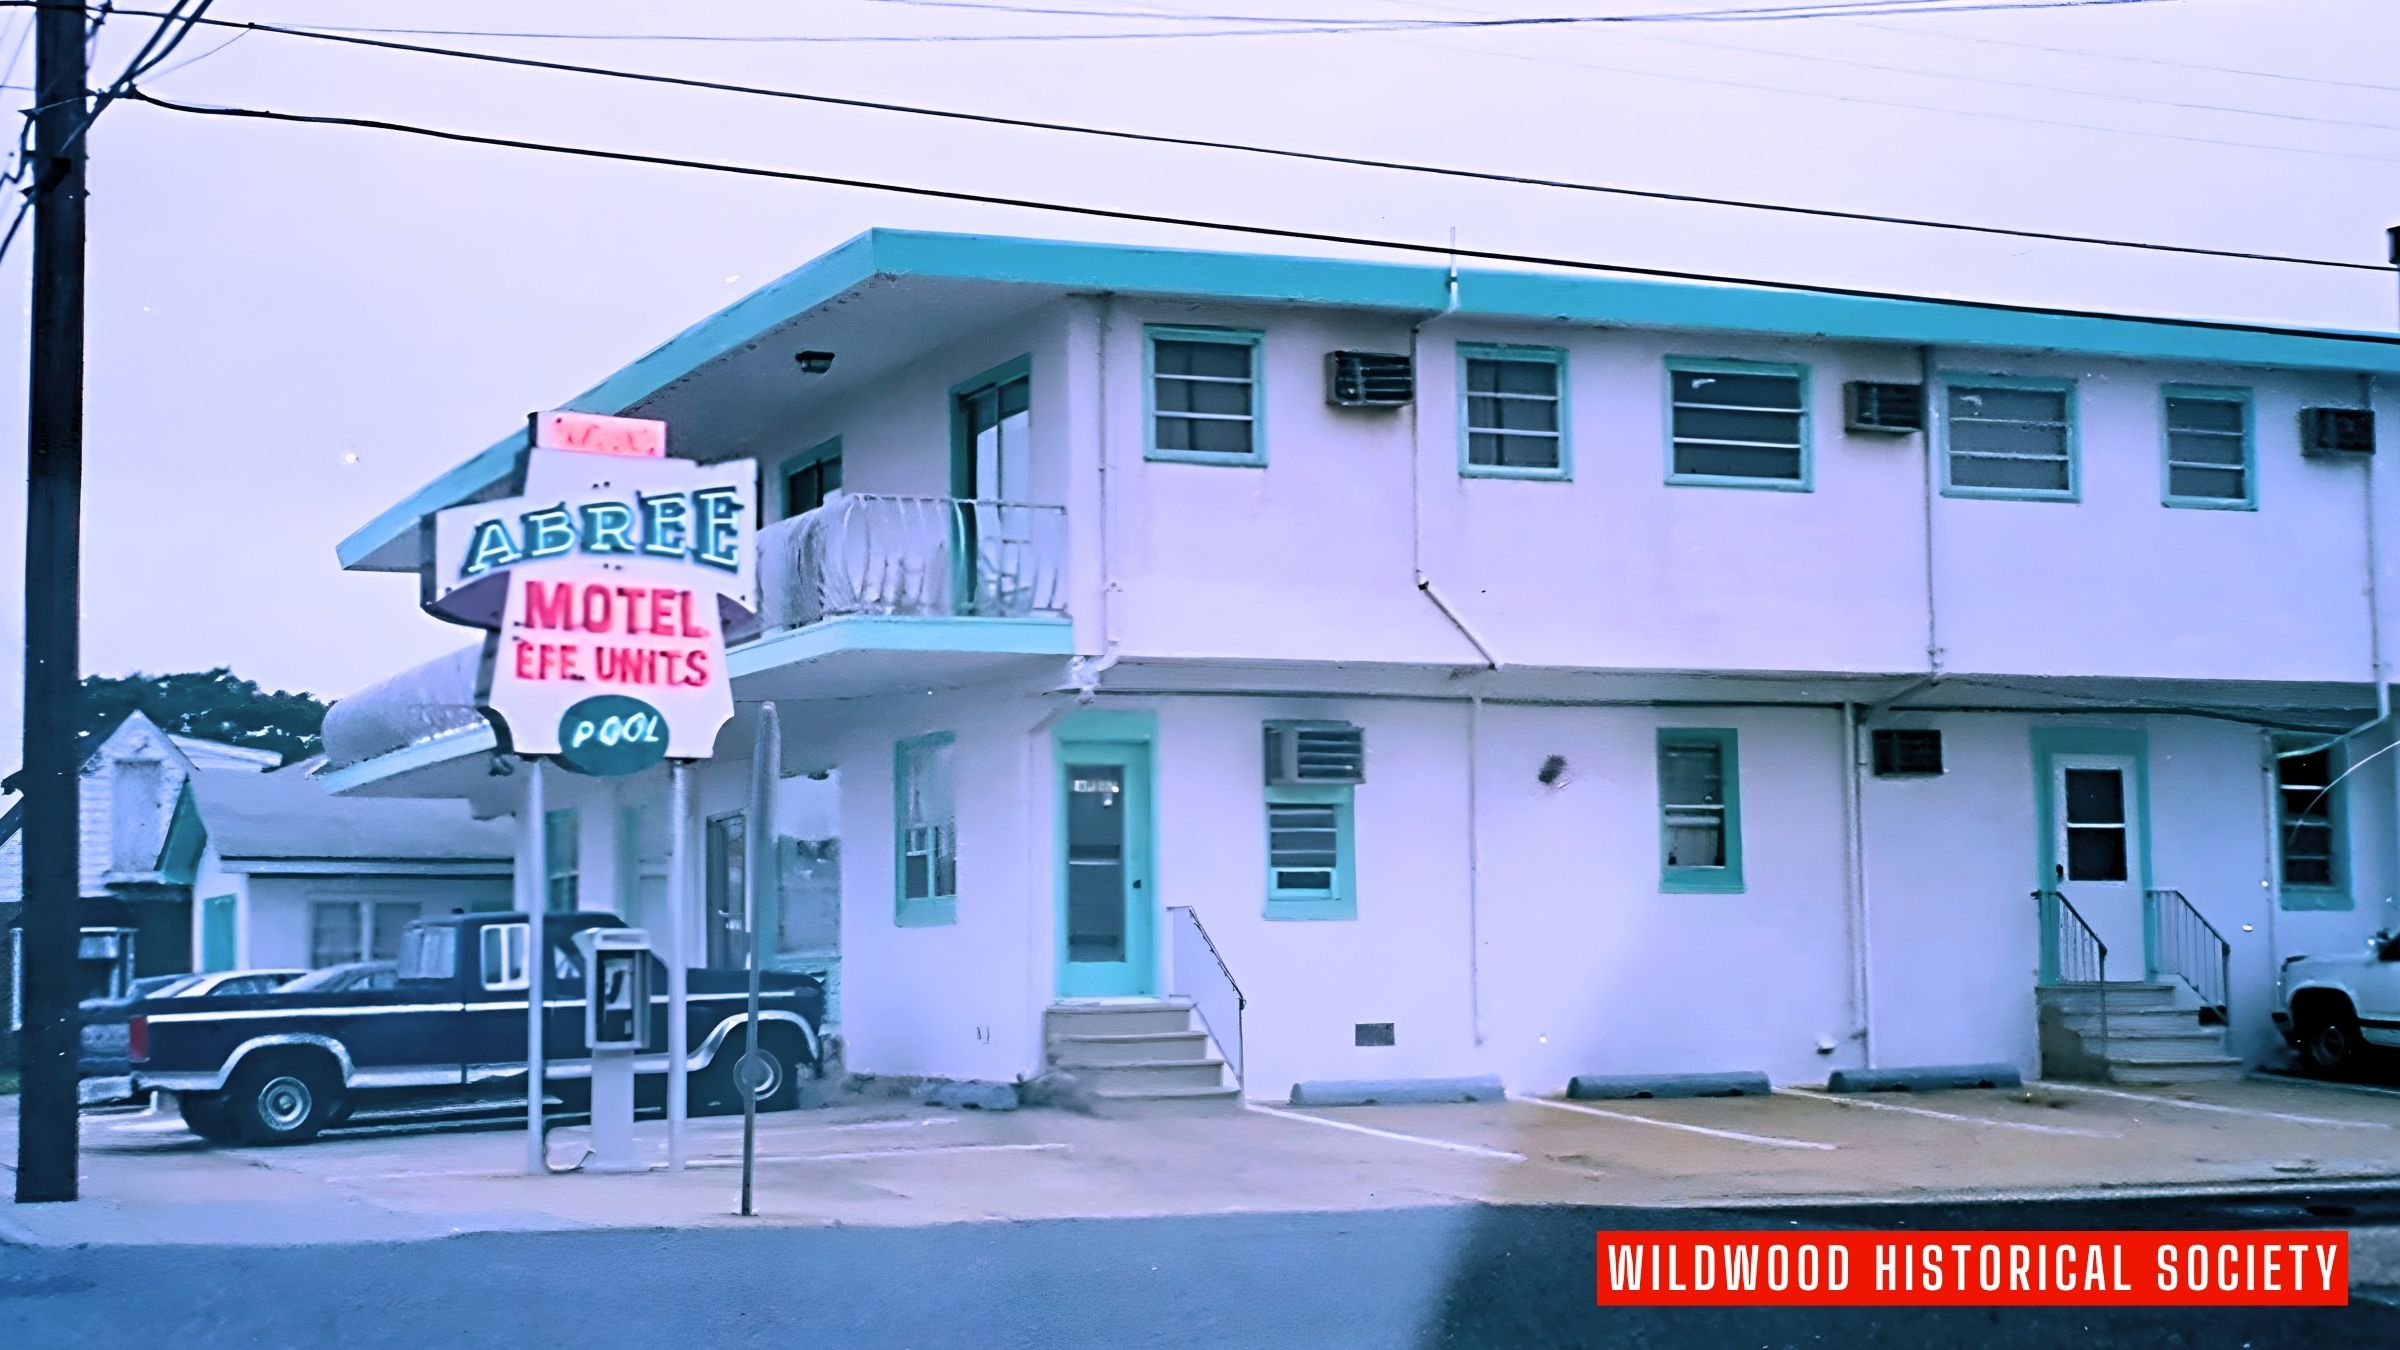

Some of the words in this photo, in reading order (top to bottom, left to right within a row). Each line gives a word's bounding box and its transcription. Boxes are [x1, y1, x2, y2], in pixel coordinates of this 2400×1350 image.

[460, 486, 742, 577] ABREE
[525, 580, 709, 638] MOTEL
[596, 645, 710, 687] UNITS
[572, 711, 660, 748] POOL
